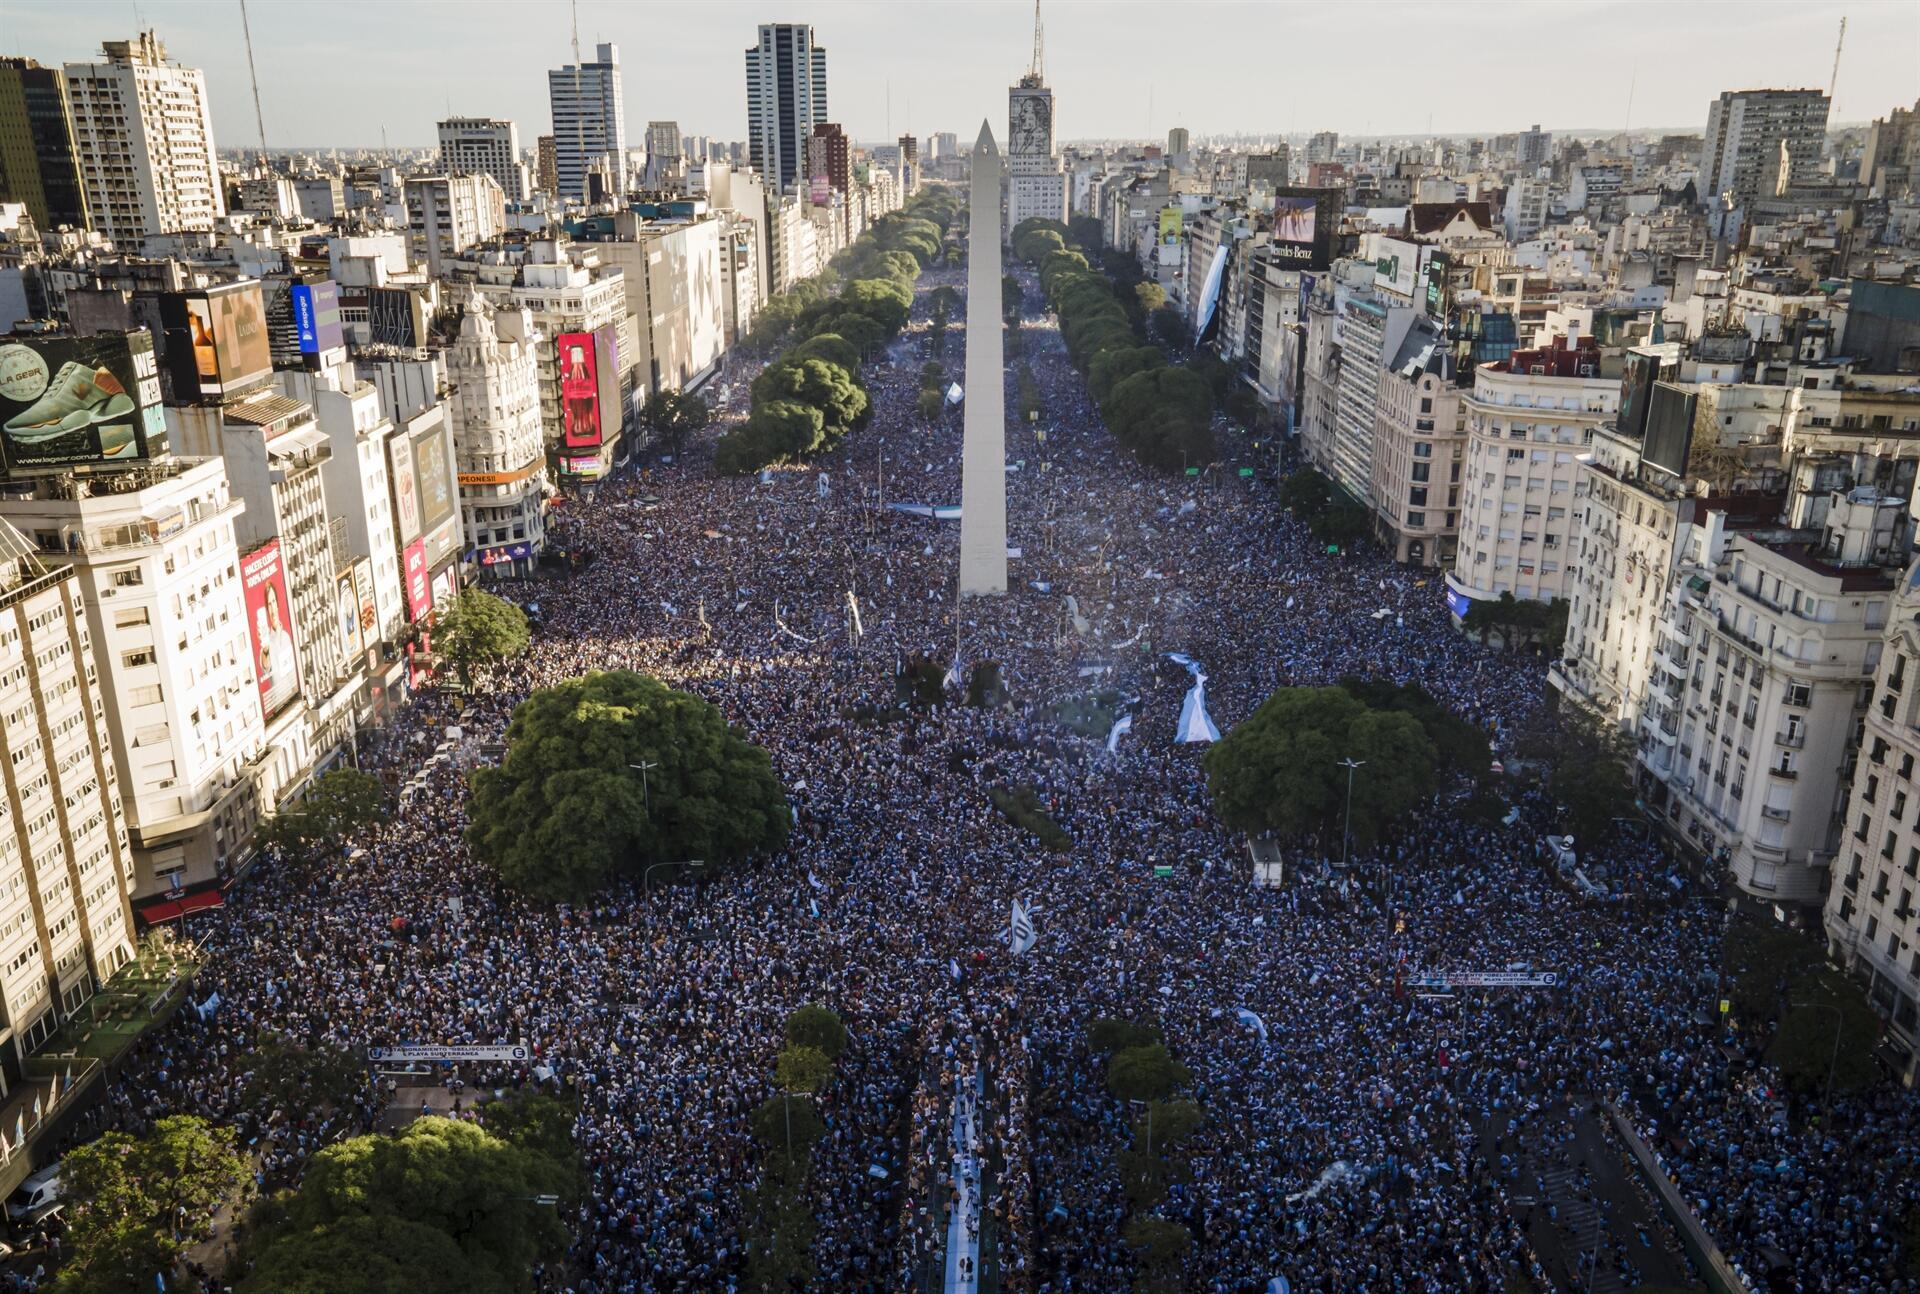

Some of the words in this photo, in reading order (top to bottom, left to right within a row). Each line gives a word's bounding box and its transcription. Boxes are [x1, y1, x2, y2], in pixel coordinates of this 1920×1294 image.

[300, 295, 309, 329] despegar
[0, 375, 13, 386] LA
[15, 367, 42, 381] GEAR
[133, 350, 158, 379] WE
[16, 453, 100, 465] www.lagear.com.ar
